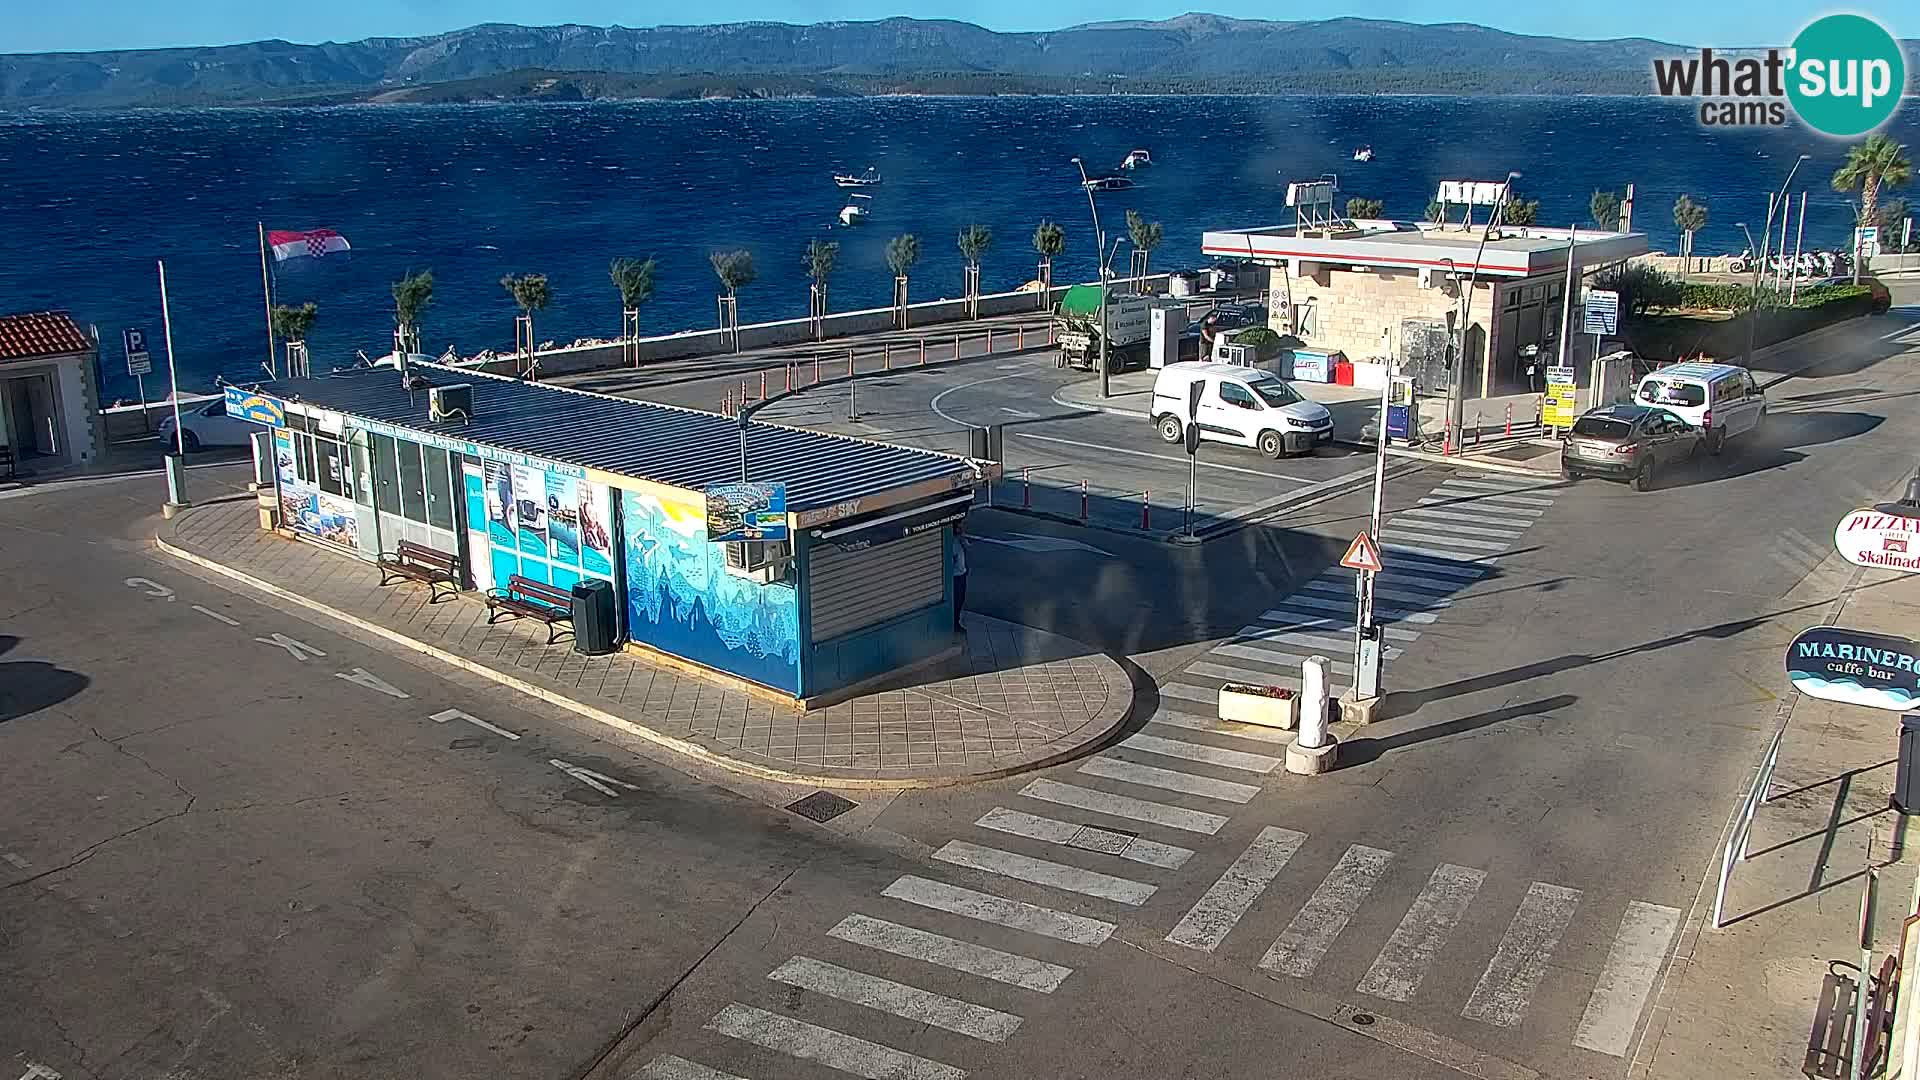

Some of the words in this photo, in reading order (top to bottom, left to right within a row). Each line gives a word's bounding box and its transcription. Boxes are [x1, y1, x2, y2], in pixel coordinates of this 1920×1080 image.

[129, 332, 142, 351] P
[436, 436, 467, 453] POSTAJA
[478, 446, 493, 458] BUS
[493, 449, 526, 467] STATION
[528, 457, 555, 473] TICKET
[555, 463, 582, 479] OFFICE
[1826, 662, 1864, 676] caffe
[1868, 665, 1896, 681] bar
